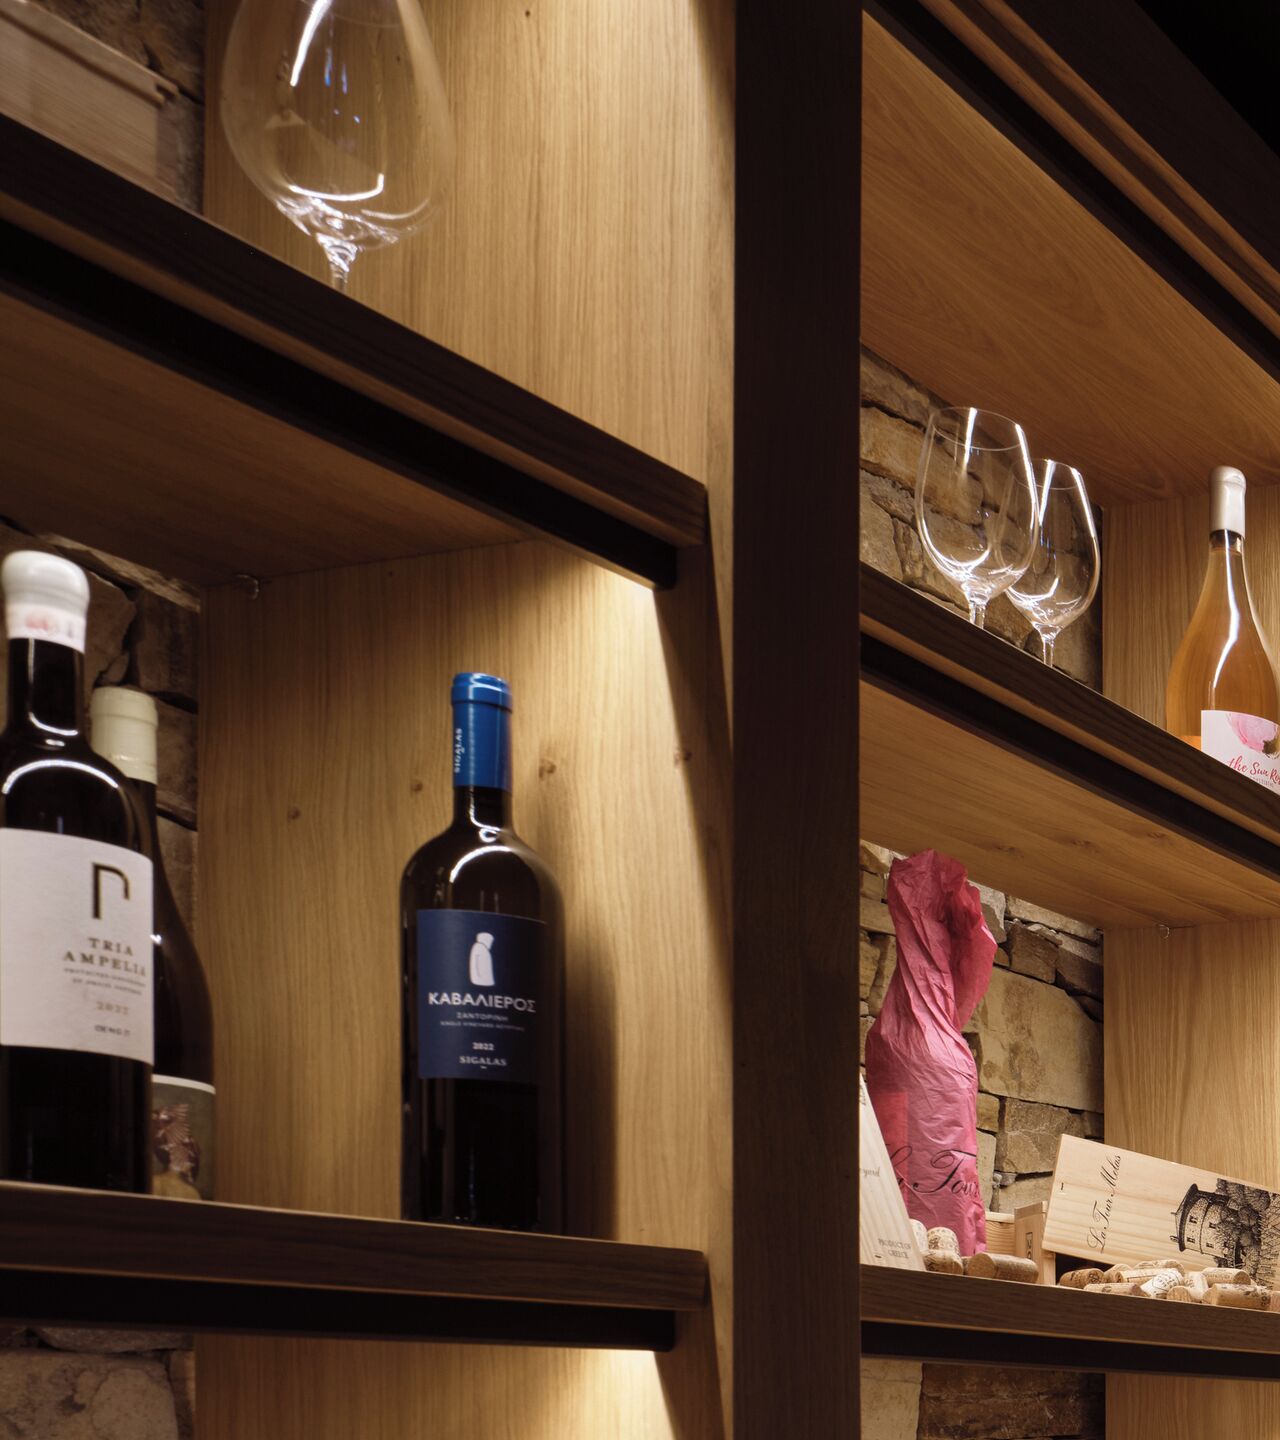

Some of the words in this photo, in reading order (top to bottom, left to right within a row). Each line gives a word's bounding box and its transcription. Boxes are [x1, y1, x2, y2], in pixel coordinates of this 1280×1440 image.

[88, 937, 133, 956] TRIA
[427, 991, 536, 1013] ΚΑΒΑΛΙΕΡΟΣ
[459, 1055, 507, 1067] SIGALAS
